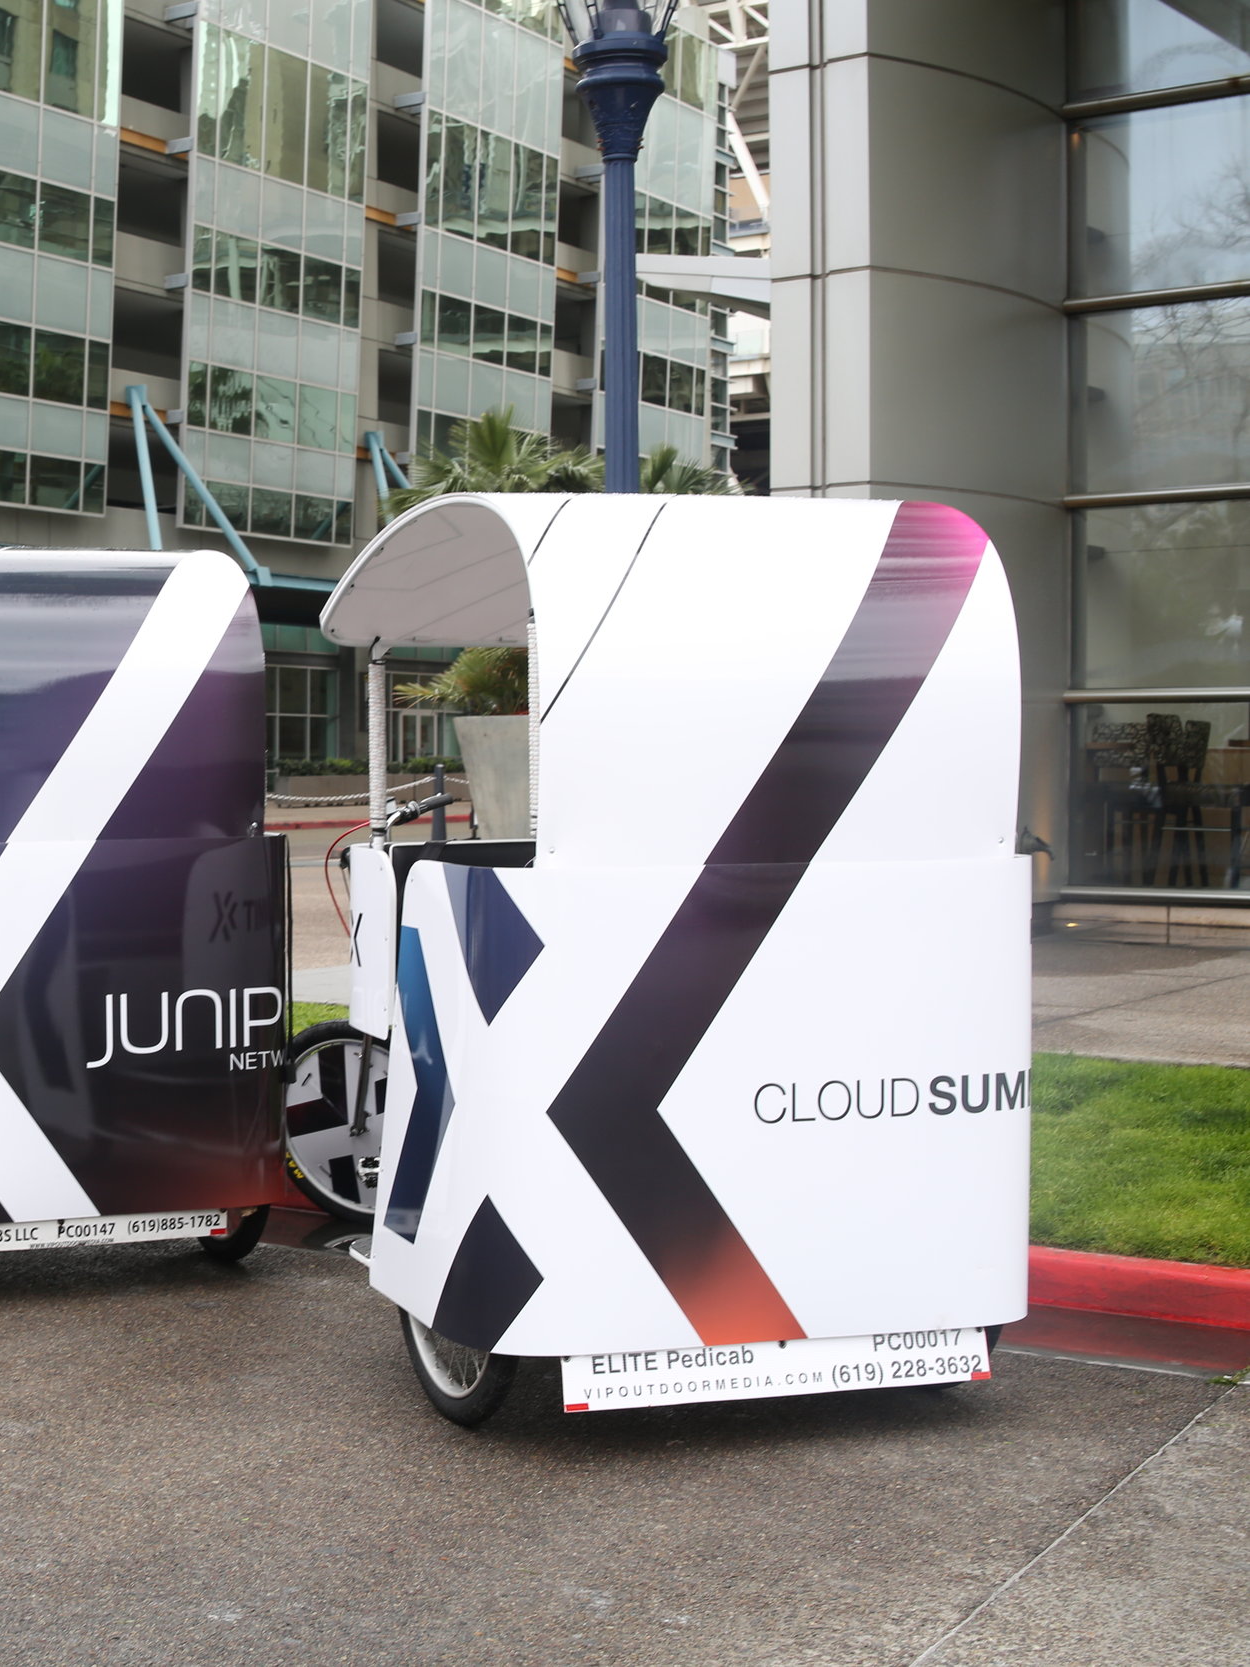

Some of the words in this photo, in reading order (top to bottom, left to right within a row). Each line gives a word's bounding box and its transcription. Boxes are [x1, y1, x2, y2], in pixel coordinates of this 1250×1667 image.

[86, 986, 282, 1068] JUNIP
[15, 1227, 39, 1242] LLC
[58, 1222, 116, 1239] PC00147
[127, 1213, 221, 1235] (619)885-1782
[592, 1352, 658, 1374] ELITE
[667, 1346, 754, 1369] Pedicab
[873, 1328, 962, 1351] PC00017
[584, 1371, 824, 1399] VIPOUTDOORMEDIA.COM
[832, 1361, 884, 1388] (619)
[891, 1354, 982, 1379] 228-3632
